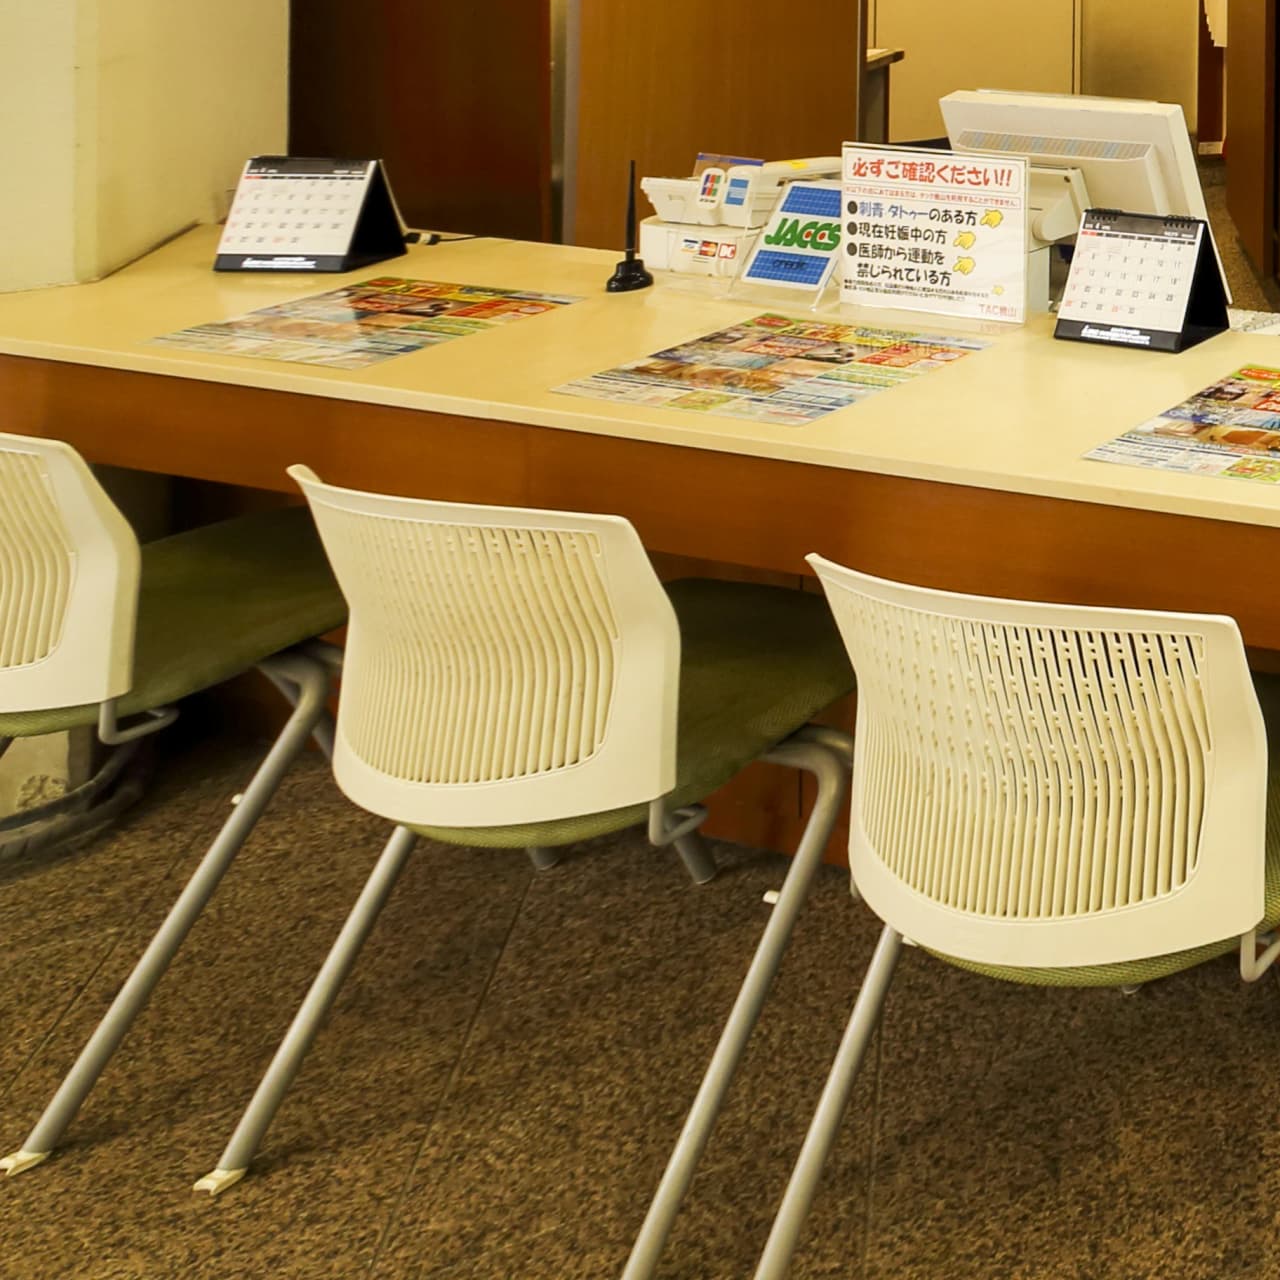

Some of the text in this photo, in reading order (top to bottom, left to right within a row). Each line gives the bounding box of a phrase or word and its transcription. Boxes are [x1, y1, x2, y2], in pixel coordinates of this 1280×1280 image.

[764, 218, 841, 251] JACCS
[858, 222, 948, 245] 現在妊娠中の方
[858, 243, 945, 265] 医師から運動を
[857, 263, 952, 287] 禁じられている方
